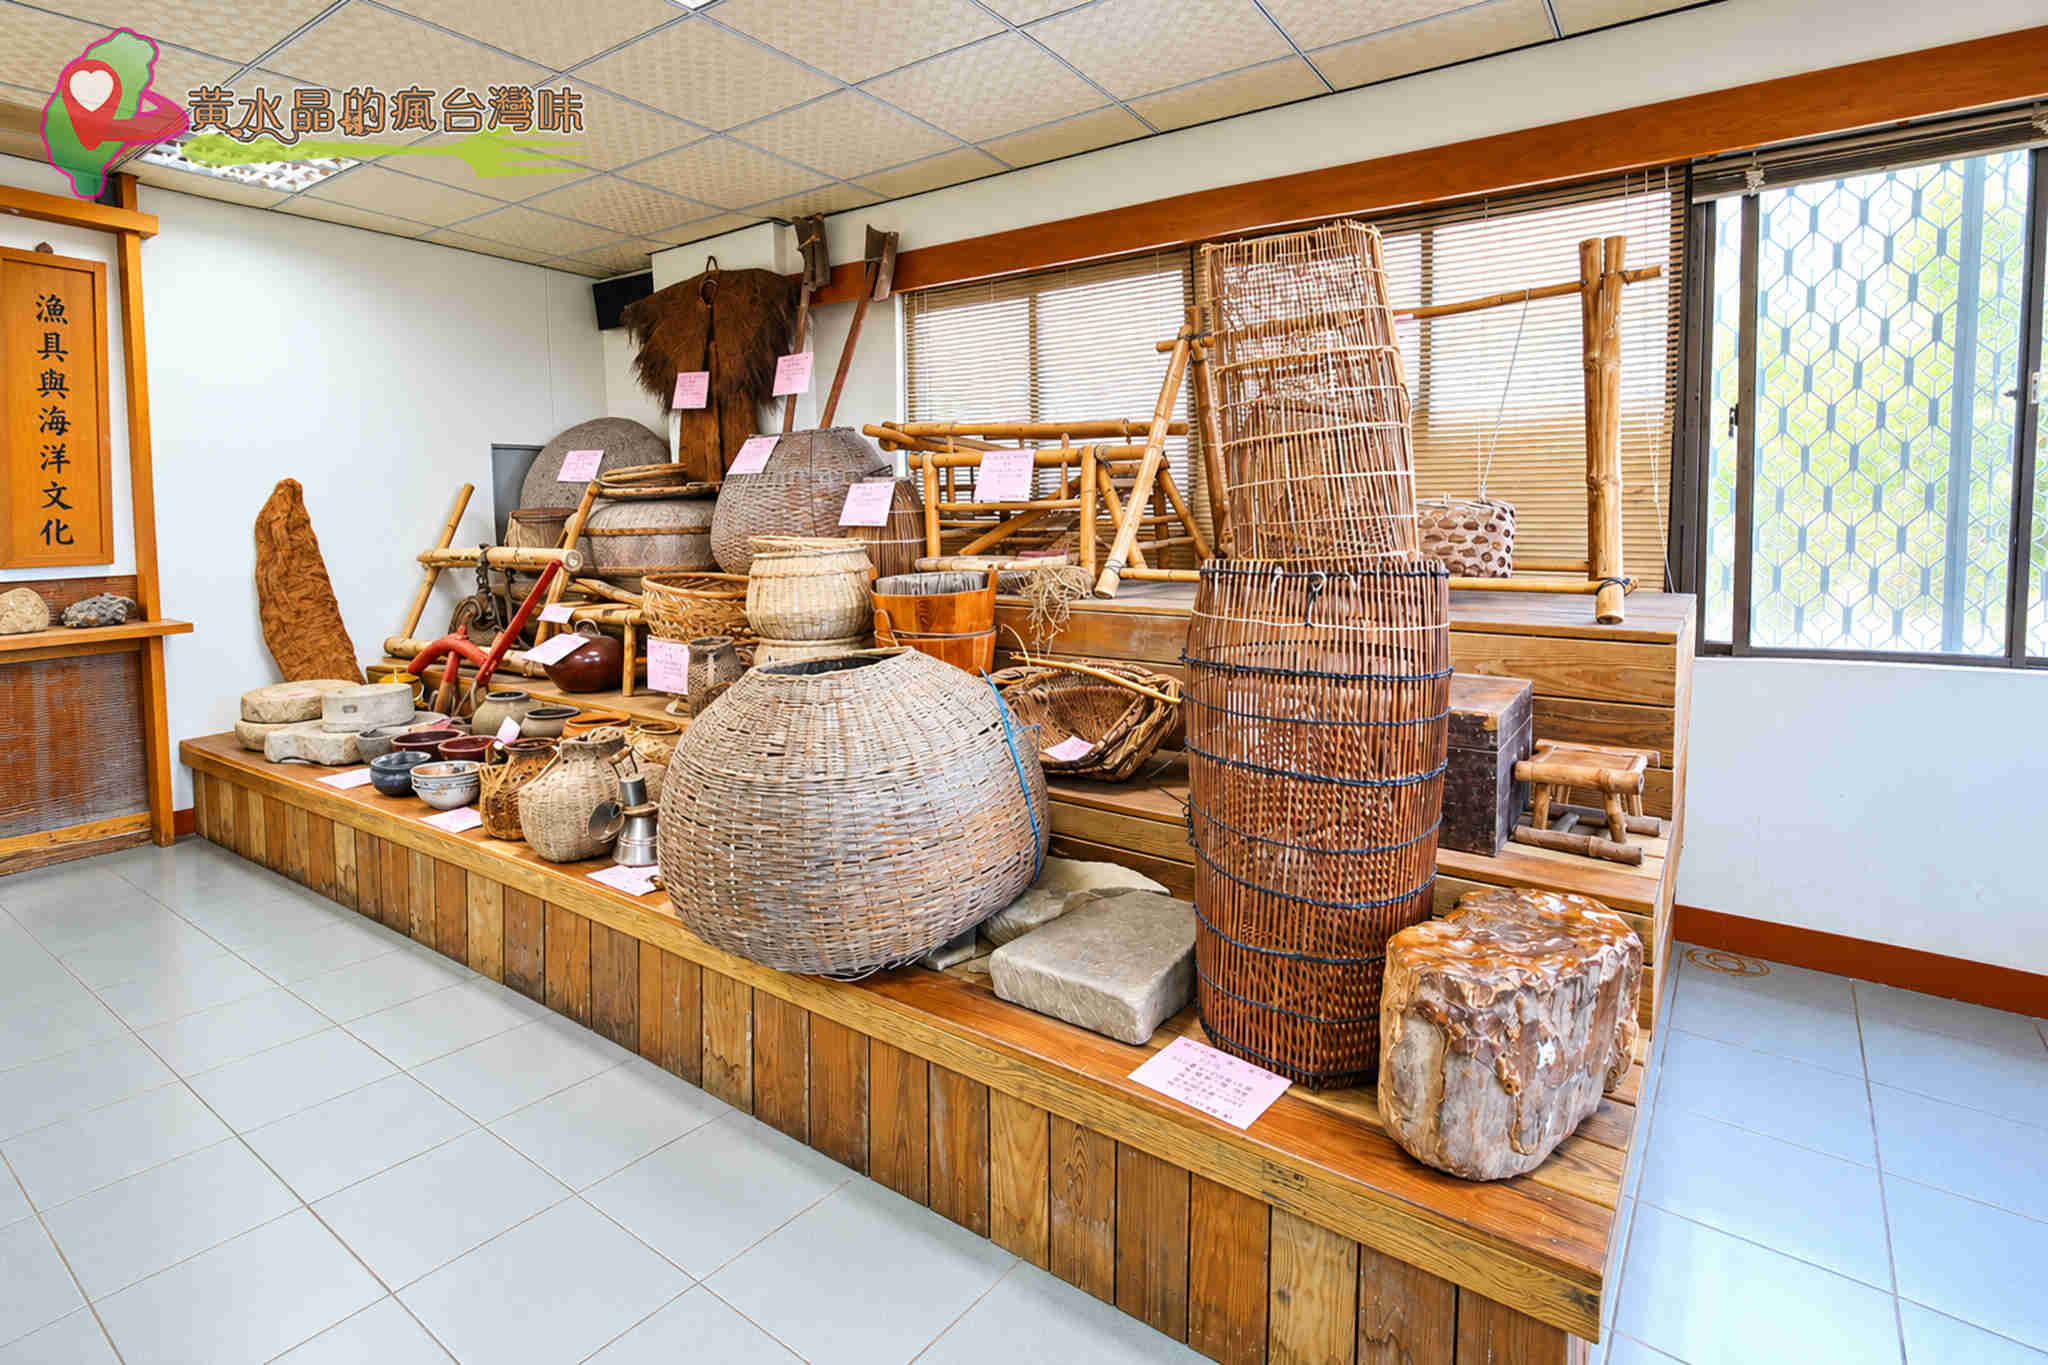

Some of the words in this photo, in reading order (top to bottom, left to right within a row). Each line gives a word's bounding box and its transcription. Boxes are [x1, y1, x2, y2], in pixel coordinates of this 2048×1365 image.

[35, 293, 75, 547] 漁具與海洋文化
